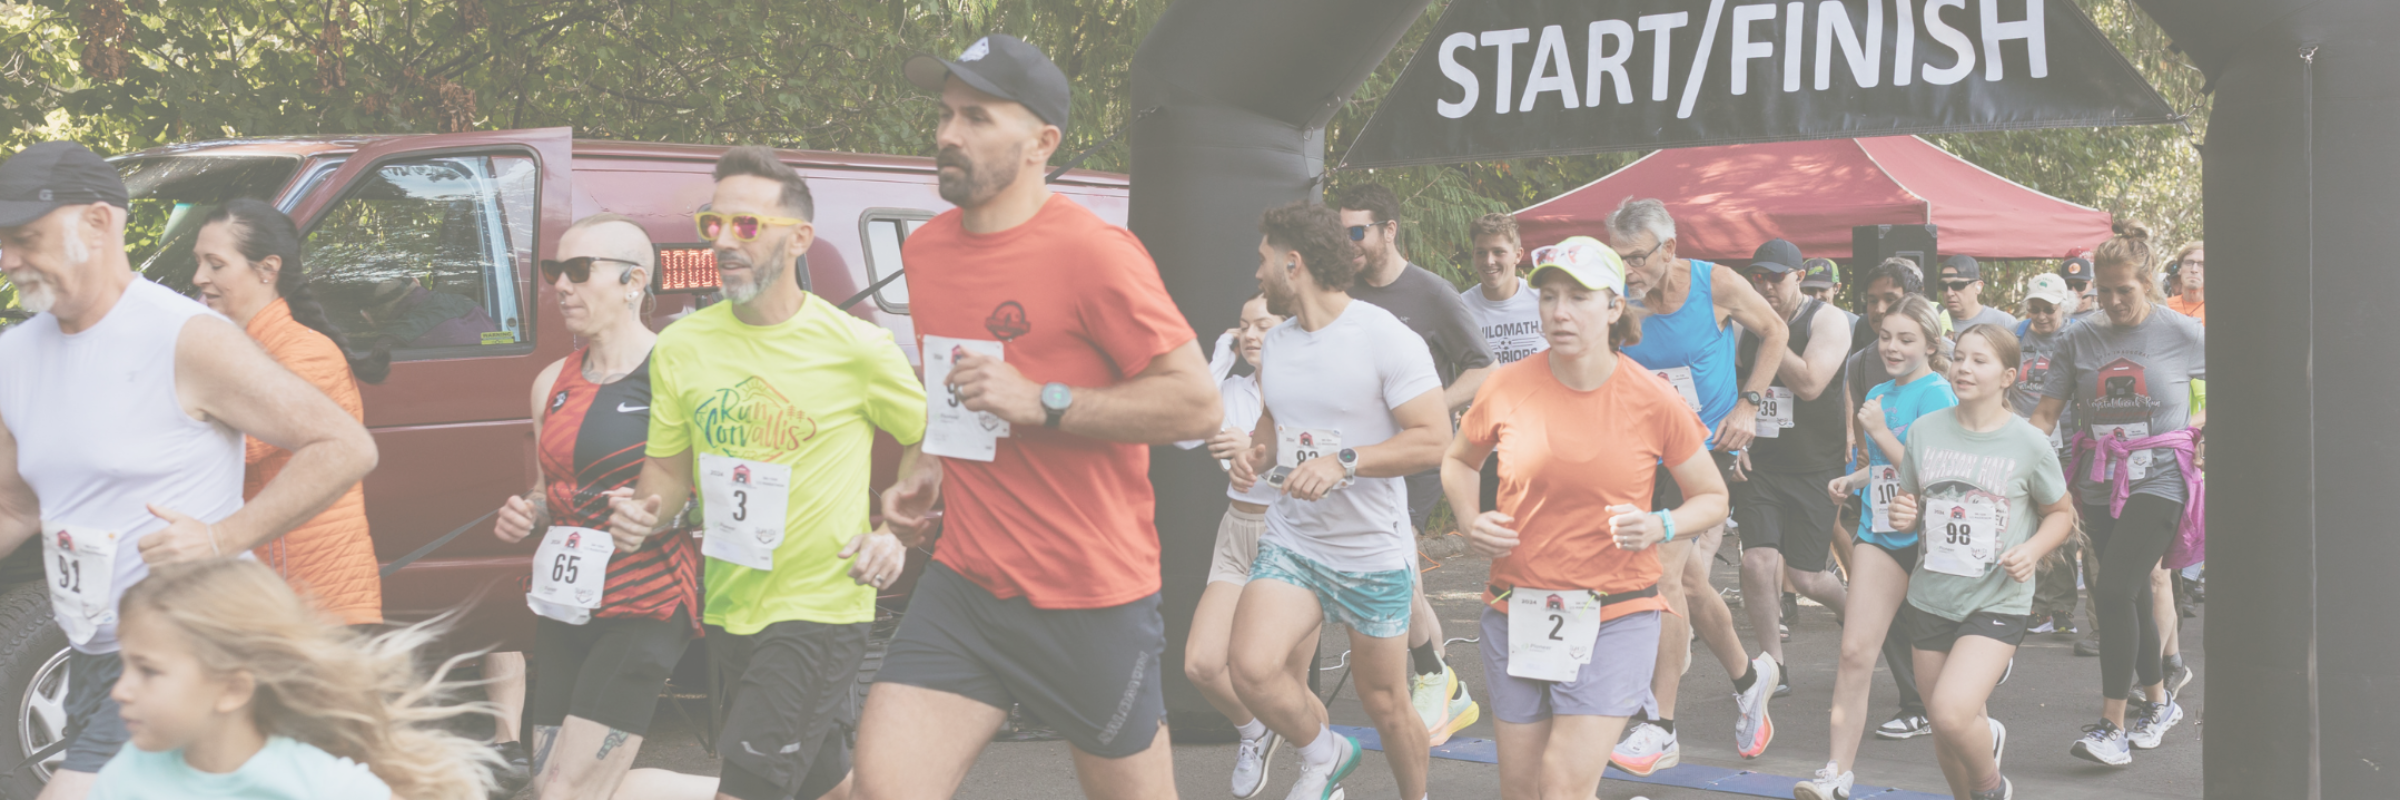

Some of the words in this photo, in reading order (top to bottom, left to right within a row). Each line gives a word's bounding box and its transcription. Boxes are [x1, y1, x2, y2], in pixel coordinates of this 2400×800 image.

[1437, 0, 2047, 119] START/FINISH
[716, 388, 768, 423] Run
[1761, 400, 1777, 417] 39
[705, 408, 805, 451] Corvallis
[733, 489, 747, 522] 3
[1878, 483, 1900, 504] 10
[1946, 522, 1971, 546] 98
[58, 554, 81, 593] 91
[552, 553, 581, 584] 65
[1549, 613, 1564, 641] 2
